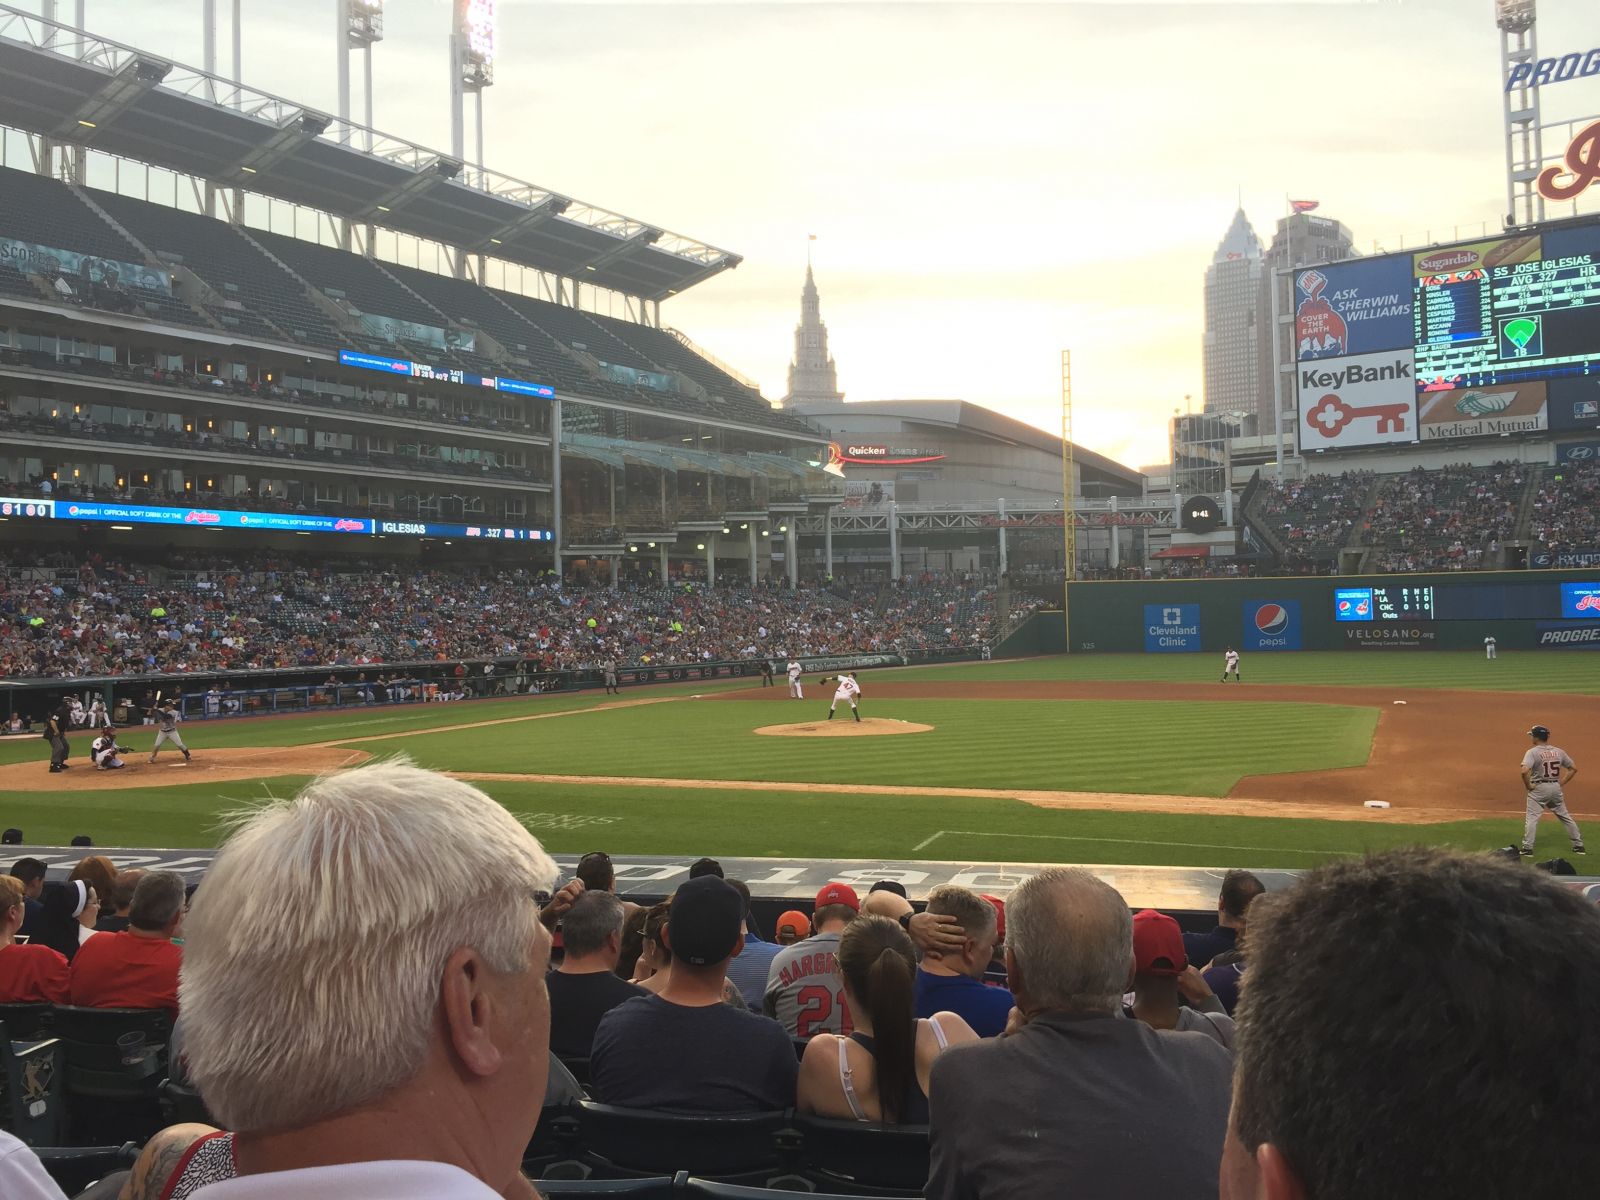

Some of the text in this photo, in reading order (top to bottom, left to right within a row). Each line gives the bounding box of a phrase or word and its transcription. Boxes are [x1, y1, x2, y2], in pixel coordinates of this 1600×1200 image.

[1504, 48, 1600, 92] PROG
[1420, 253, 1478, 270] Sugardale
[1494, 255, 1591, 276] SS JOSE IGLESIAS
[1511, 266, 1596, 286] AVG .327 HR
[1332, 288, 1358, 300] ASK
[1338, 295, 1398, 311] SHERWIN
[1427, 302, 1455, 311] MARTINEZ
[1301, 314, 1328, 322] COVER
[1347, 304, 1411, 322] WILLIAMS
[1427, 309, 1455, 317] CESPEDES
[1427, 315, 1455, 324] MARTINEZ
[1302, 326, 1329, 334] EARTH
[1302, 360, 1410, 390] KeyBank
[1428, 417, 1538, 438] Medical Mutual
[849, 446, 885, 456] Quicken
[14, 503, 20, 515] 1
[383, 522, 425, 534] IGLESIAS
[485, 528, 501, 538] .327
[519, 530, 523, 539] 1
[1150, 626, 1196, 635] Cleveland
[1347, 629, 1434, 639] VELOSANO.org
[1159, 637, 1186, 646] Clinic
[1260, 638, 1286, 647] pepsi
[1543, 761, 1560, 777] 15
[797, 985, 854, 1037] 21
